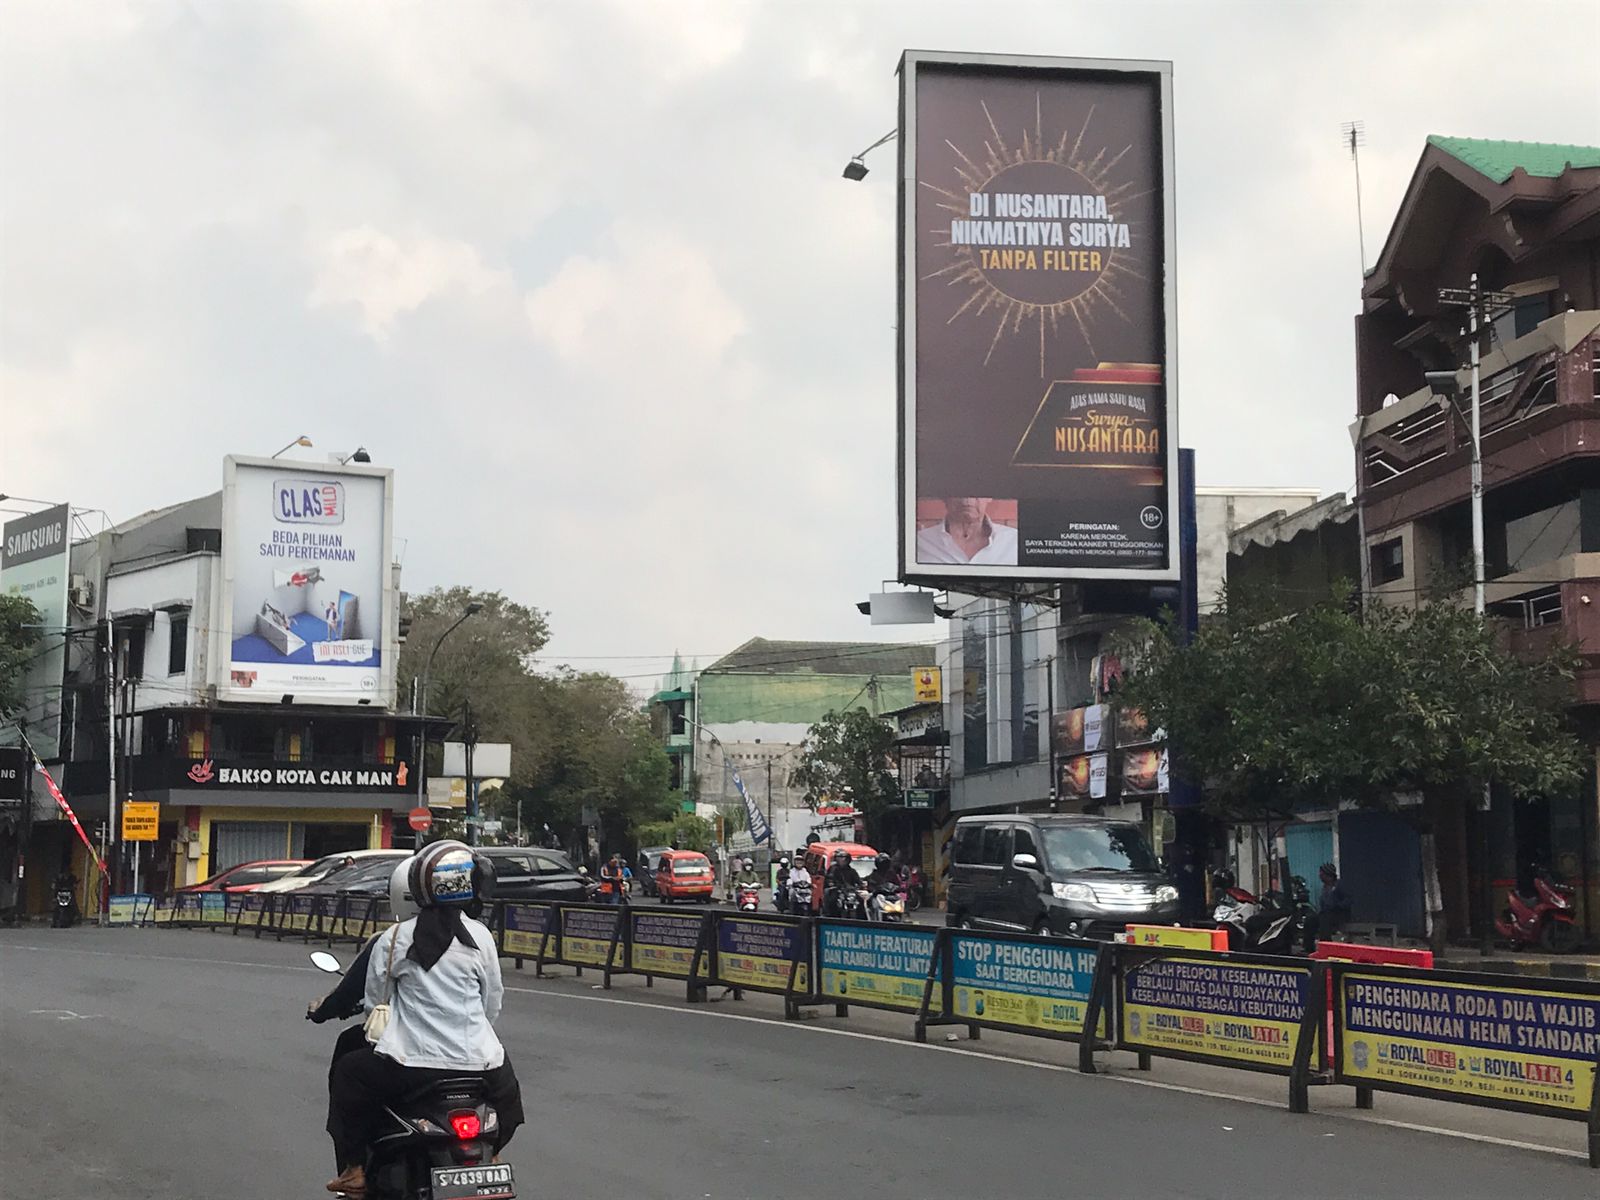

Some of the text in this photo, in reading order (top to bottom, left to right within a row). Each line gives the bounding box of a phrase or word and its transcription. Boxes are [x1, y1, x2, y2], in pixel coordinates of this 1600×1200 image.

[970, 193, 1113, 222] DI NUSANTARA,
[951, 220, 1131, 248] NIKMATNYA SURYA
[980, 249, 1101, 272] TANPA FILTER
[1070, 394, 1087, 411] ATAS
[1088, 392, 1108, 406] NAMA
[1128, 395, 1146, 413] RASA
[1084, 410, 1135, 432] Surya
[1055, 427, 1159, 454] NUSANTARA
[280, 486, 338, 518] CLAS MILD
[1069, 523, 1120, 531] PERINGATAN:
[1143, 513, 1159, 523] 18+
[7, 522, 62, 558] SAMSUNG
[272, 530, 343, 547] BEDA PILIHAN
[1044, 540, 1078, 548] TERKENA
[1079, 541, 1108, 549] KANKER
[1060, 533, 1090, 541] KARENA
[259, 543, 356, 562] SATU PERTEMANAN
[219, 768, 392, 786] BAKSO KOTA CAK MAN
[825, 930, 872, 949] TAATILAH
[824, 949, 842, 963] DAN
[843, 950, 876, 968] RAMBU
[878, 954, 902, 971] LALU
[958, 940, 1098, 974] STOP PENGGUNA HP
[976, 963, 1000, 980] SAAT
[1002, 965, 1075, 989] BERKENDARA
[1176, 965, 1219, 982] PELOPOR
[1221, 969, 1297, 989] KESELAMATAN
[1136, 975, 1300, 1004] BERLALU LINTAS DAN BUDAYAKAN
[1131, 988, 1306, 1020] KESELAMATAN SEBAGAI KEBUTUHAN
[1356, 984, 1597, 1029] PENGENDARA RODA DUA WAJIB
[1155, 1013, 1183, 1029] ROYAL
[1224, 1022, 1254, 1040] ROYAL
[1255, 1027, 1280, 1044] ATK
[1282, 1030, 1290, 1045] 4
[1351, 1006, 1465, 1039] MENGGUNAKAN
[1470, 1020, 1513, 1045] HELM
[1391, 1043, 1426, 1064] ROYAL
[1484, 1058, 1526, 1079] ROYAL
[1527, 1064, 1561, 1084] ATK
[1564, 1069, 1574, 1086] 4
